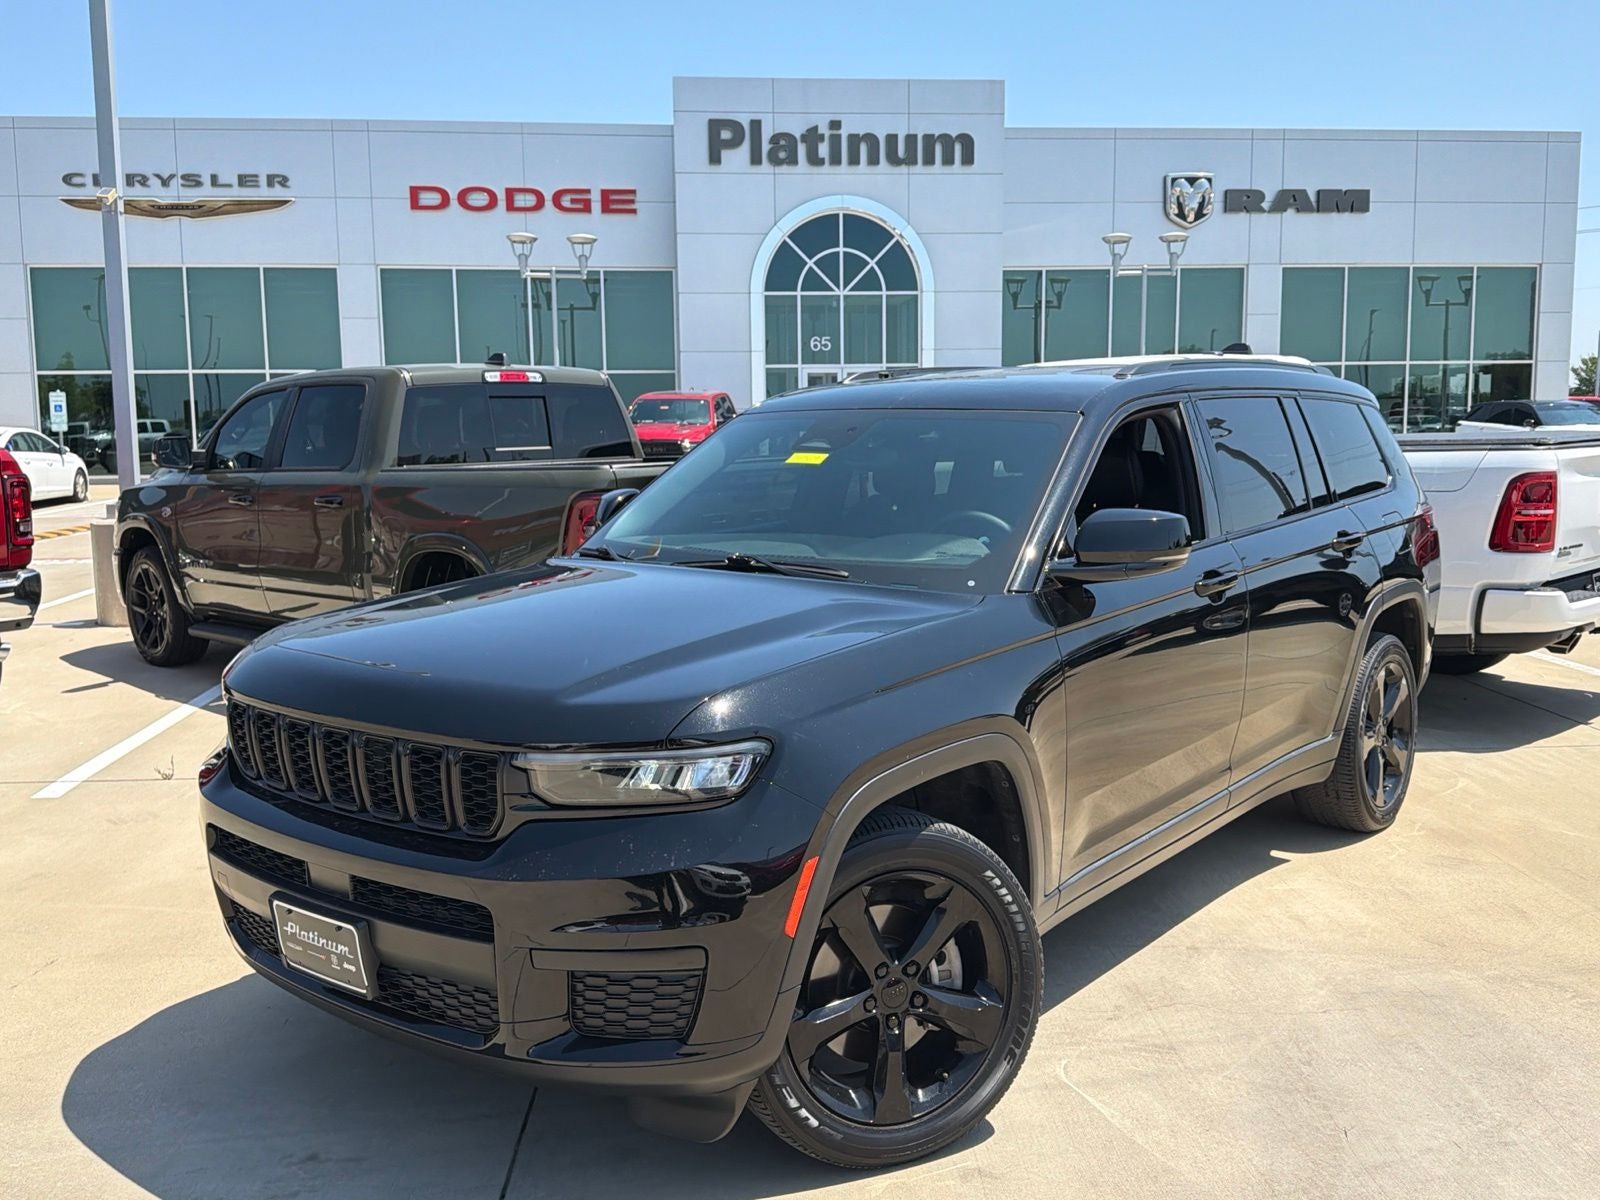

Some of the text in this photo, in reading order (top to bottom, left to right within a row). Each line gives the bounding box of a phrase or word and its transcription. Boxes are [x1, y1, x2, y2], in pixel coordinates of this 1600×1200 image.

[708, 118, 975, 166] Platinum
[409, 185, 637, 215] DODGE
[1224, 189, 1371, 214] RAM
[809, 336, 832, 353] 65
[283, 921, 354, 958] Platinum
